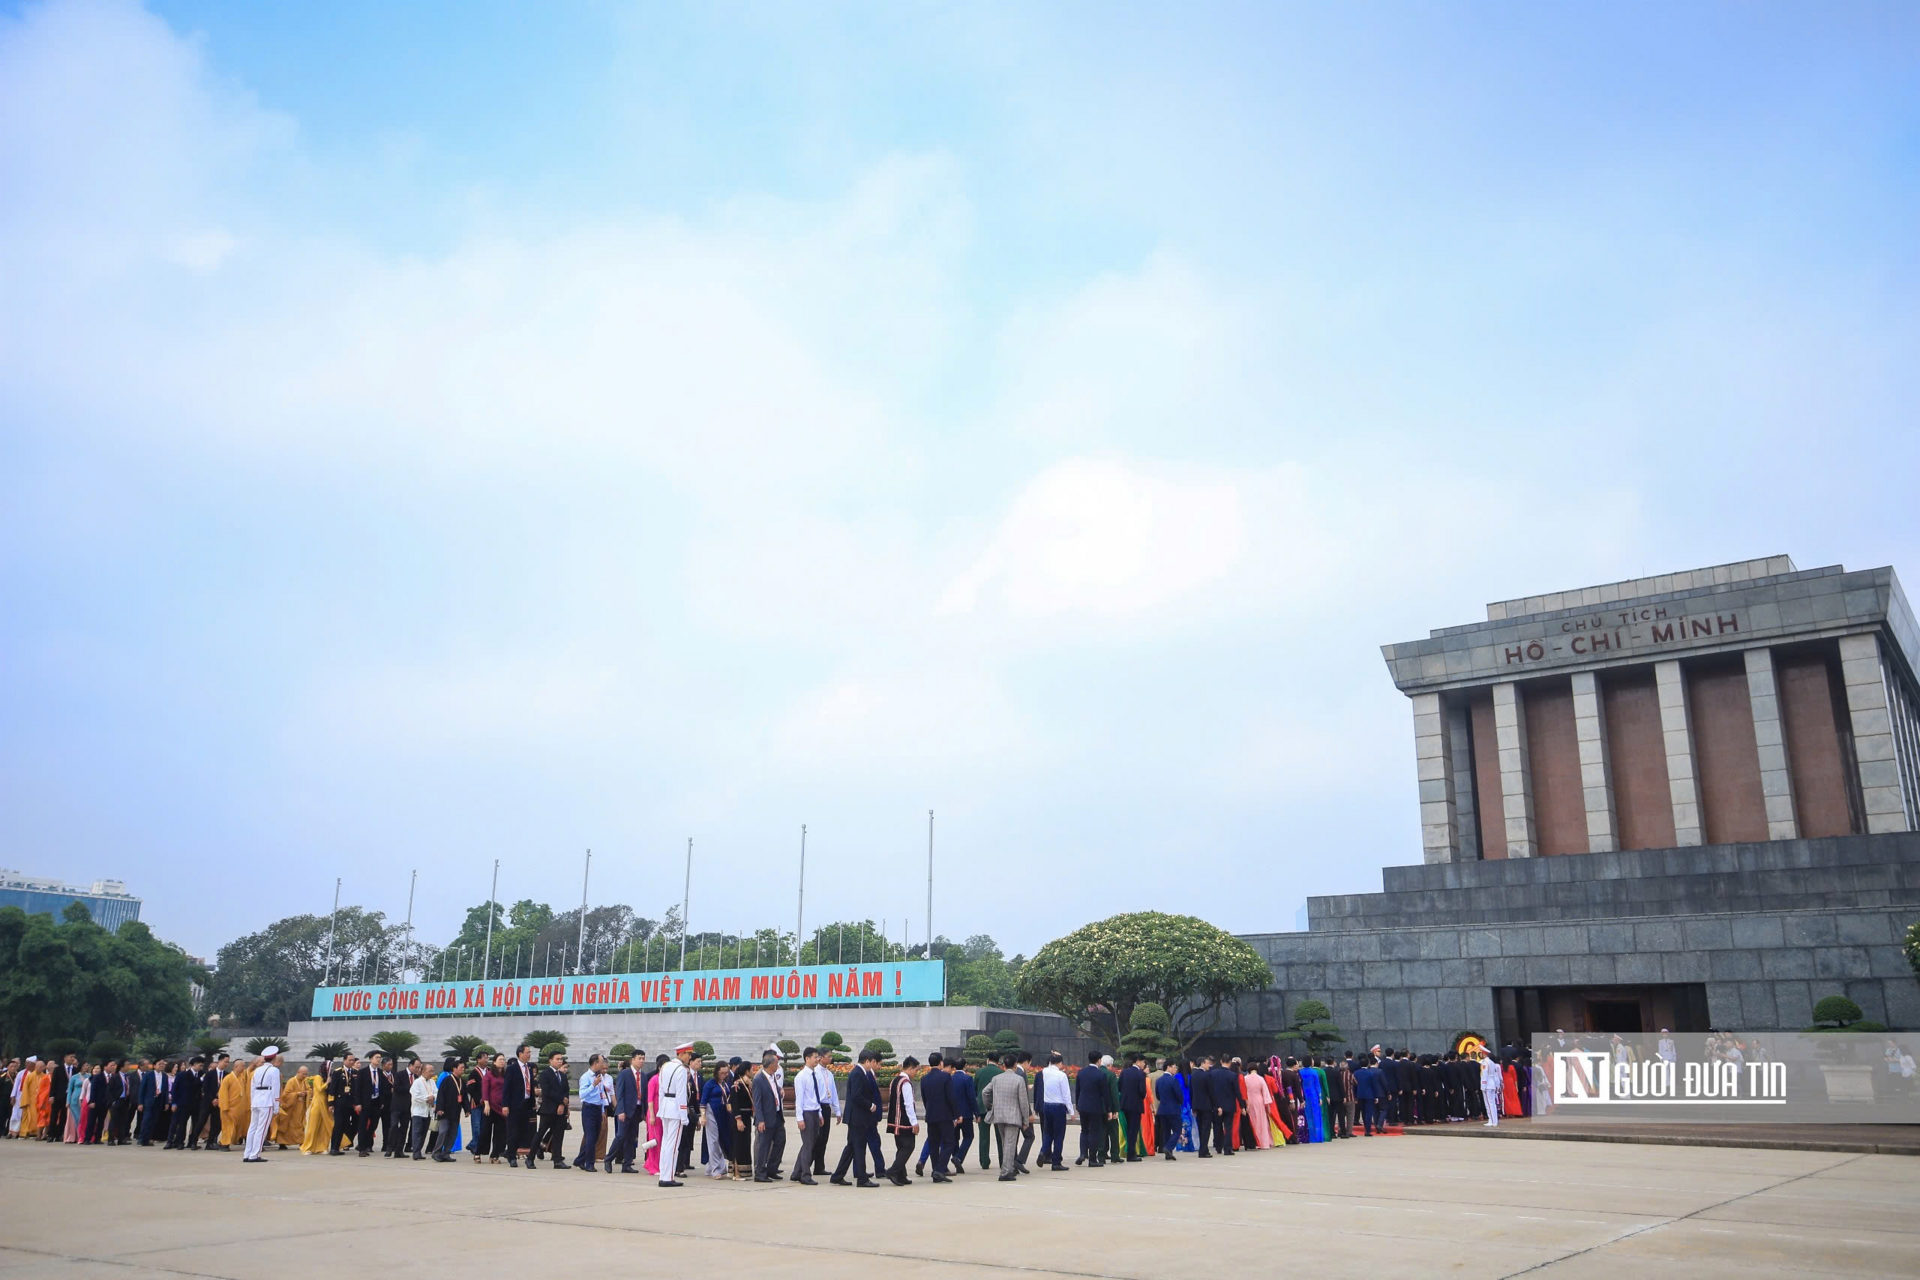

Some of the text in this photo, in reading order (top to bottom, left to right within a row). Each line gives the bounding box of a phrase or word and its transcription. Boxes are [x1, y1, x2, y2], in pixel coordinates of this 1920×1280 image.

[332, 990, 372, 1012] NƯỚC
[377, 987, 419, 1014] CỘNG
[425, 985, 457, 1009] HÒA
[463, 983, 485, 1008] XÃ
[492, 981, 521, 1011] HỘI
[528, 978, 565, 1005] CHỦ
[571, 977, 630, 1005] NGHĨA
[641, 975, 684, 1006] VIỆT
[693, 976, 741, 1001] NAM
[751, 970, 818, 999] MUÔN
[828, 967, 883, 997] NĂM
